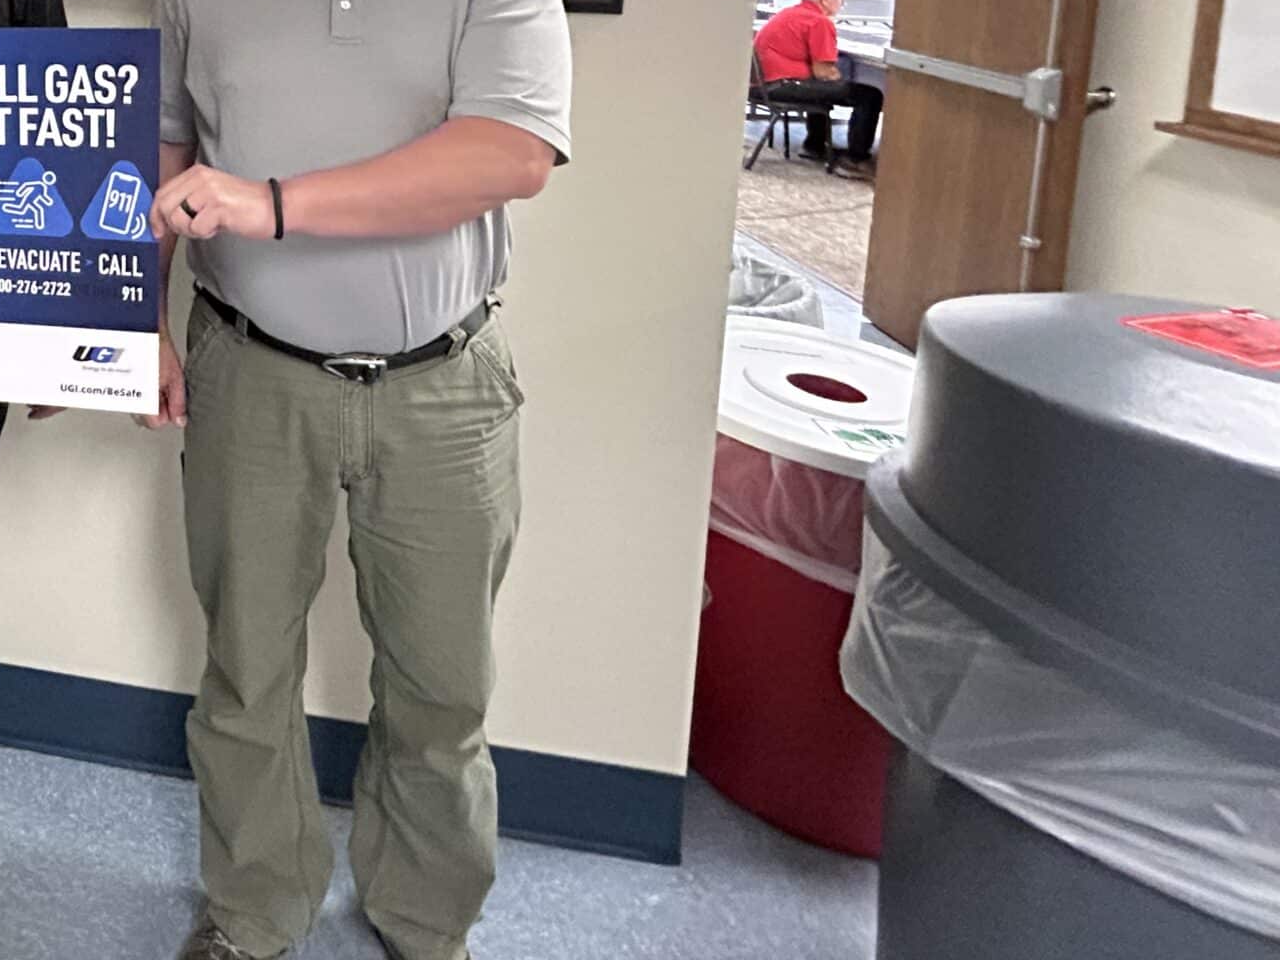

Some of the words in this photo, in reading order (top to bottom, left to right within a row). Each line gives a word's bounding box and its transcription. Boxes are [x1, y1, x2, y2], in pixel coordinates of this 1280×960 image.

[44, 63, 139, 105] GAS?
[19, 107, 116, 149] FAST!
[108, 189, 133, 213] 911
[98, 253, 144, 277] CALL
[122, 286, 144, 302] 911
[72, 345, 125, 363] UGI
[60, 383, 142, 398] UGI.com/BeSafe
